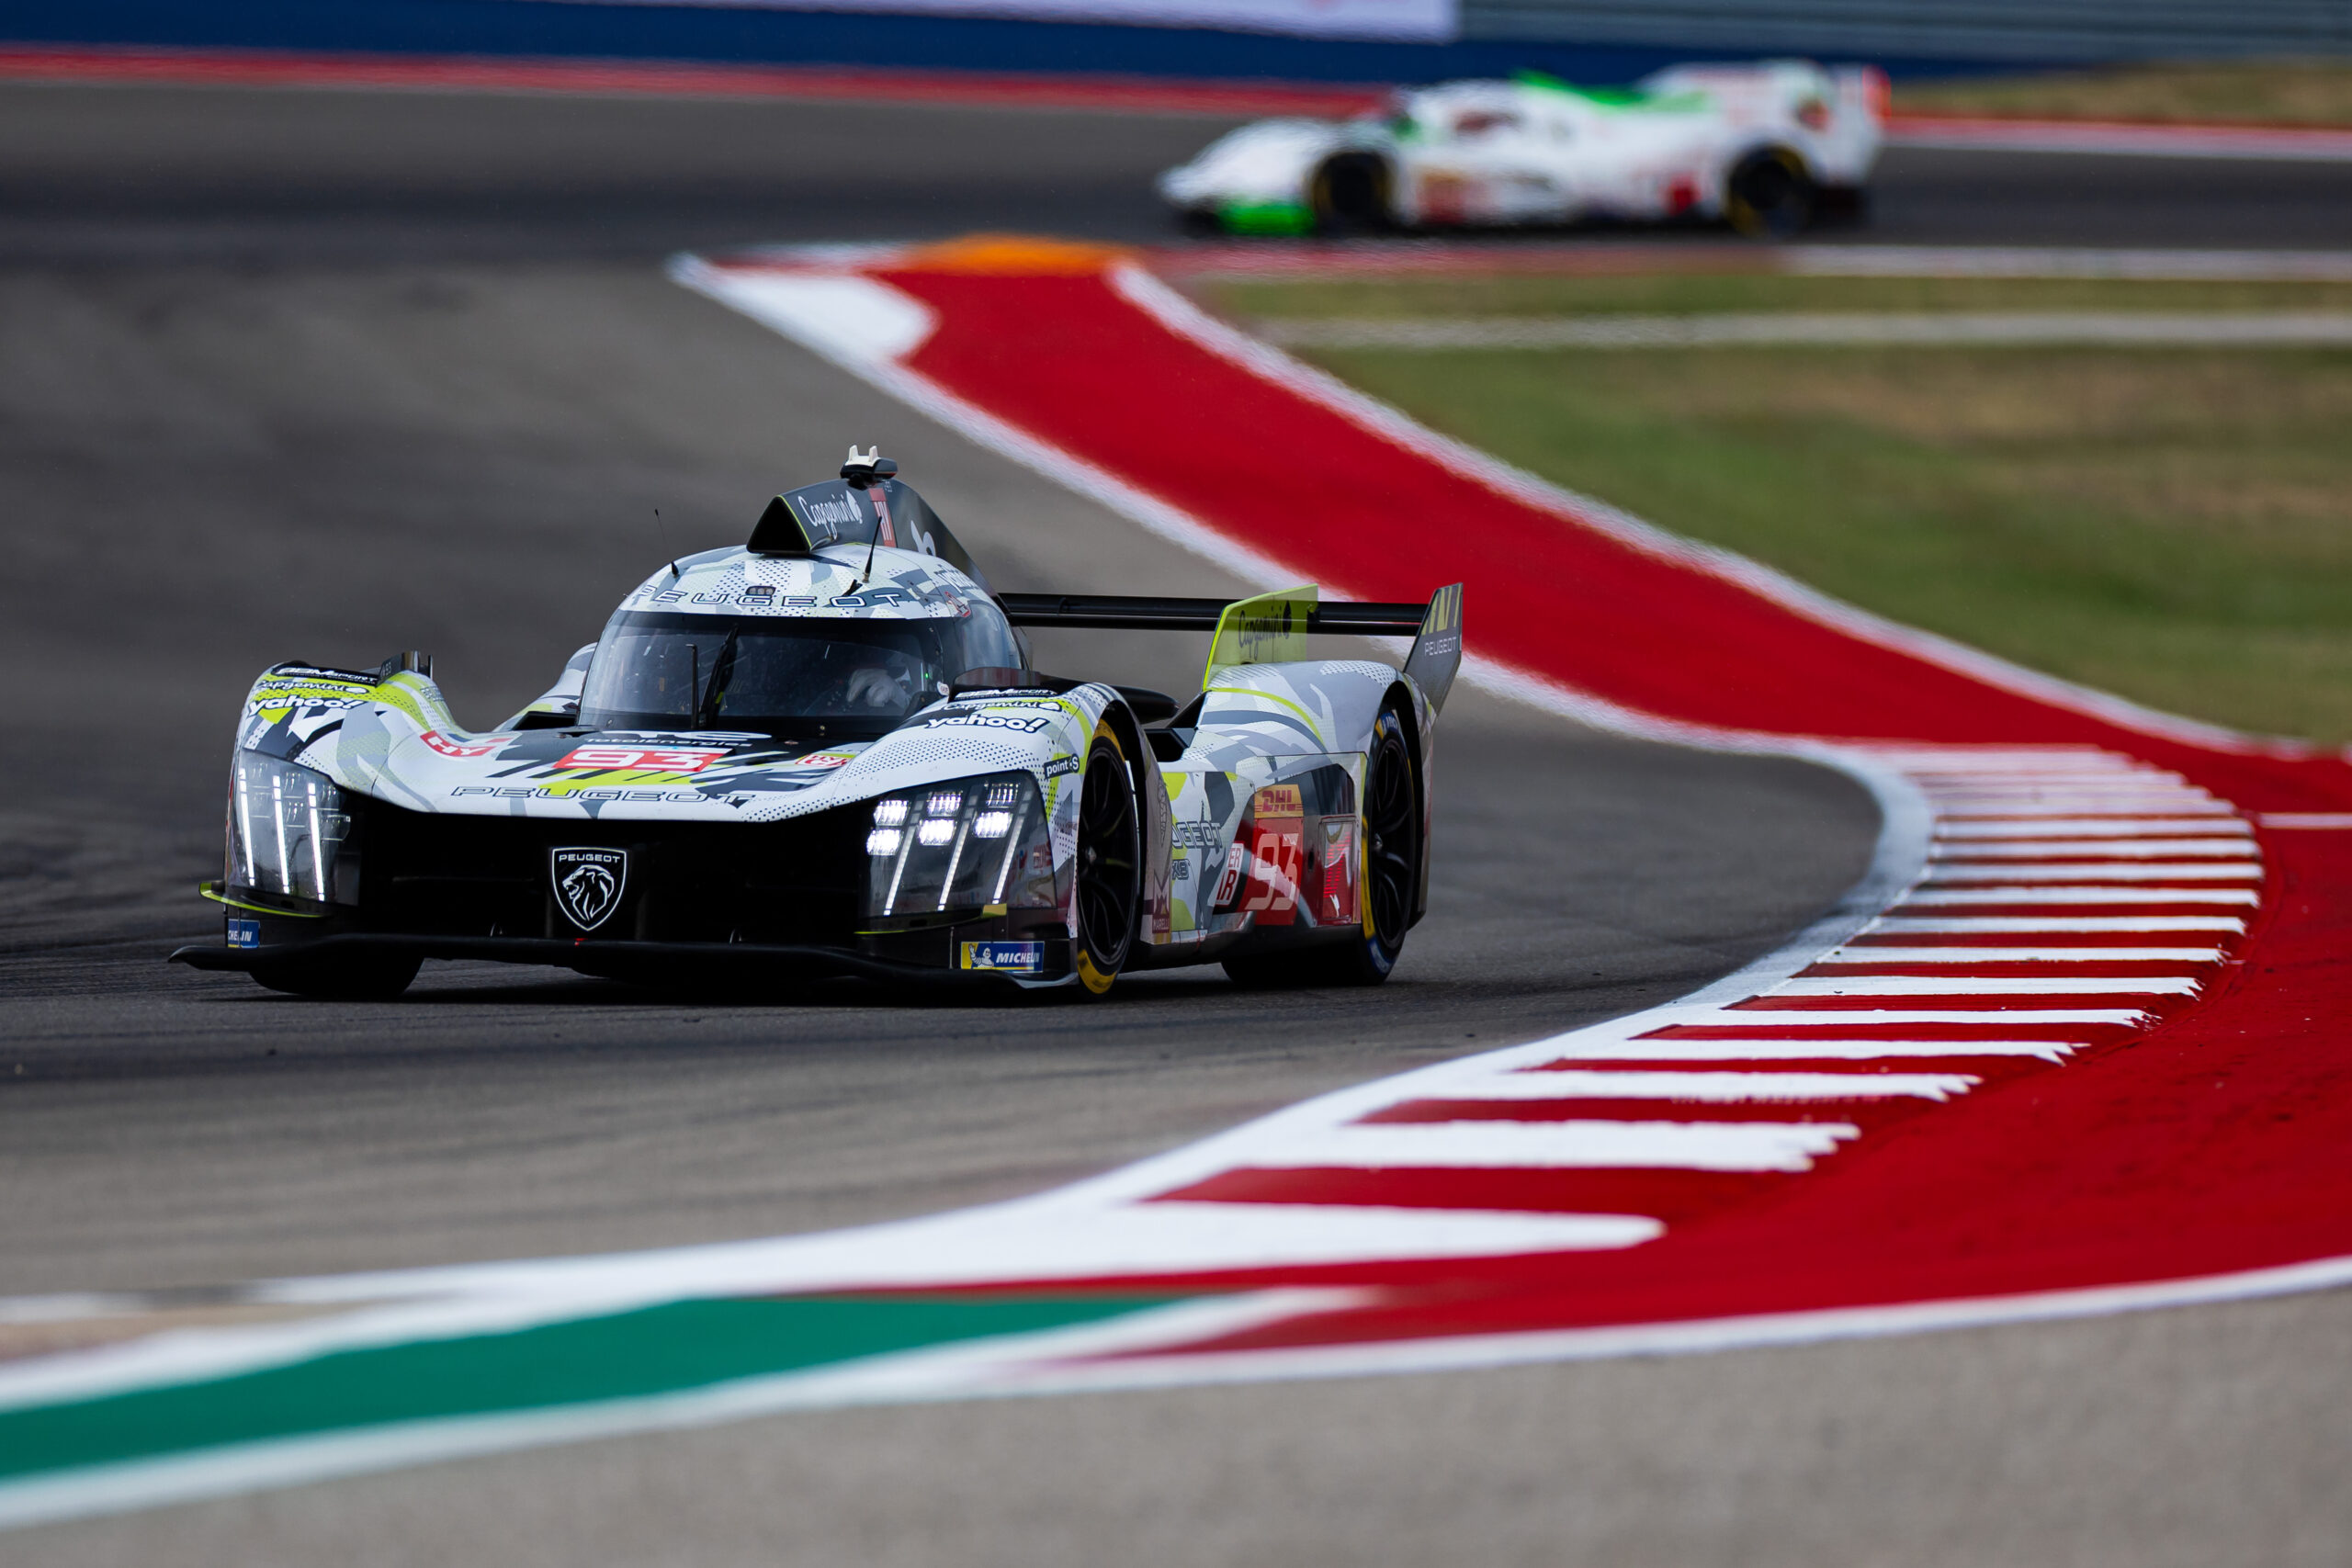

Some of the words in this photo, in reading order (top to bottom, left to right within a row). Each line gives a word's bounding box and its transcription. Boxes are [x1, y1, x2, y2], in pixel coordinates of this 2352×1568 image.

[639, 584, 900, 607] PEUGEOT
[1238, 605, 1282, 661] Capgemini
[1424, 637, 1457, 657] PEUGEOT
[247, 694, 366, 716] yahoo!
[944, 700, 1038, 712] Capgemini
[925, 714, 1048, 733] yahoo!
[564, 750, 705, 772] 93
[1046, 761, 1069, 778] point
[450, 785, 756, 804] PEUGEOT
[1262, 790, 1296, 813] DHL
[559, 853, 621, 863] PEUGEOT
[1244, 832, 1299, 910] 93
[996, 952, 1040, 964] MICHELIN
